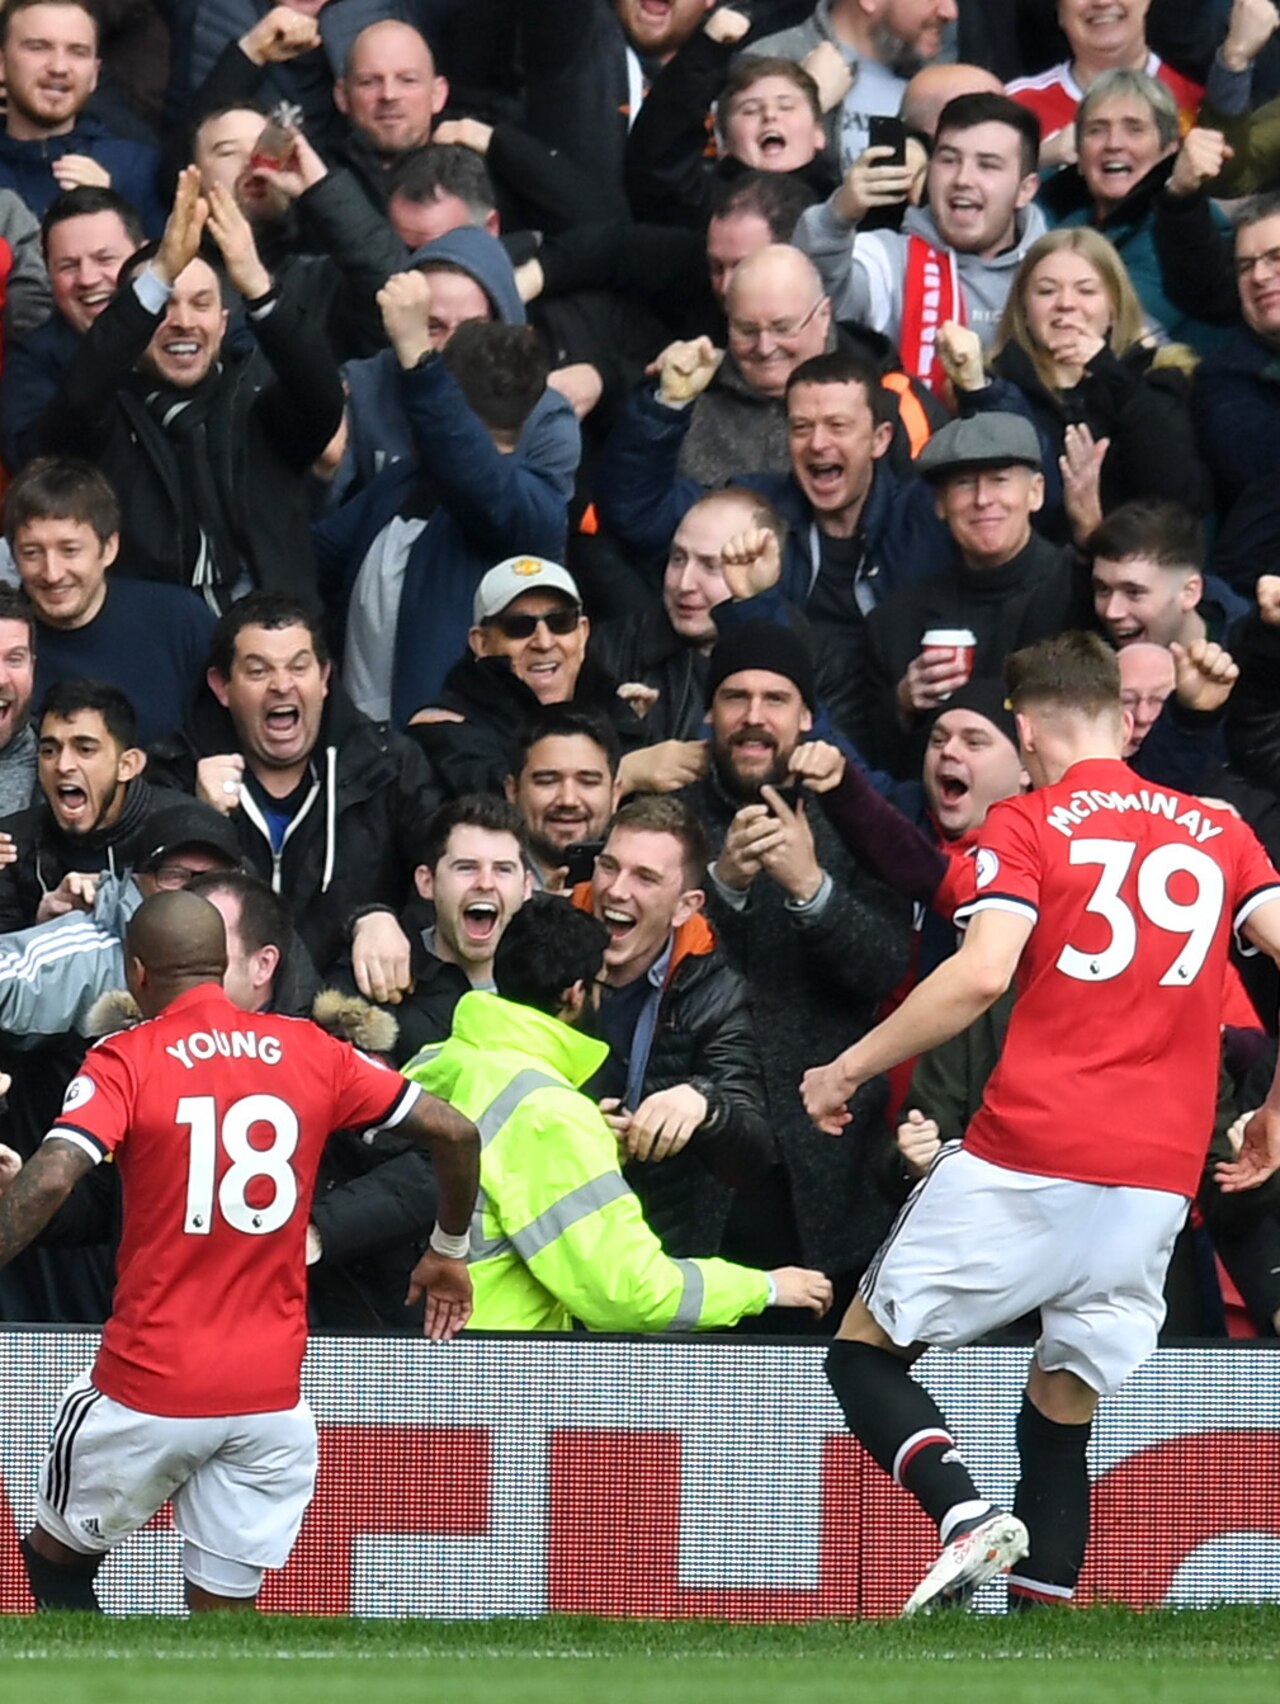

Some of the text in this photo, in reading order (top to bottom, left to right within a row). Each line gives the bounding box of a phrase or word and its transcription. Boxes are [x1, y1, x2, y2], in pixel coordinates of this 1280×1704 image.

[1055, 838, 1225, 987] 39
[166, 1028, 282, 1069] YOUNG
[175, 1094, 299, 1235] 18
